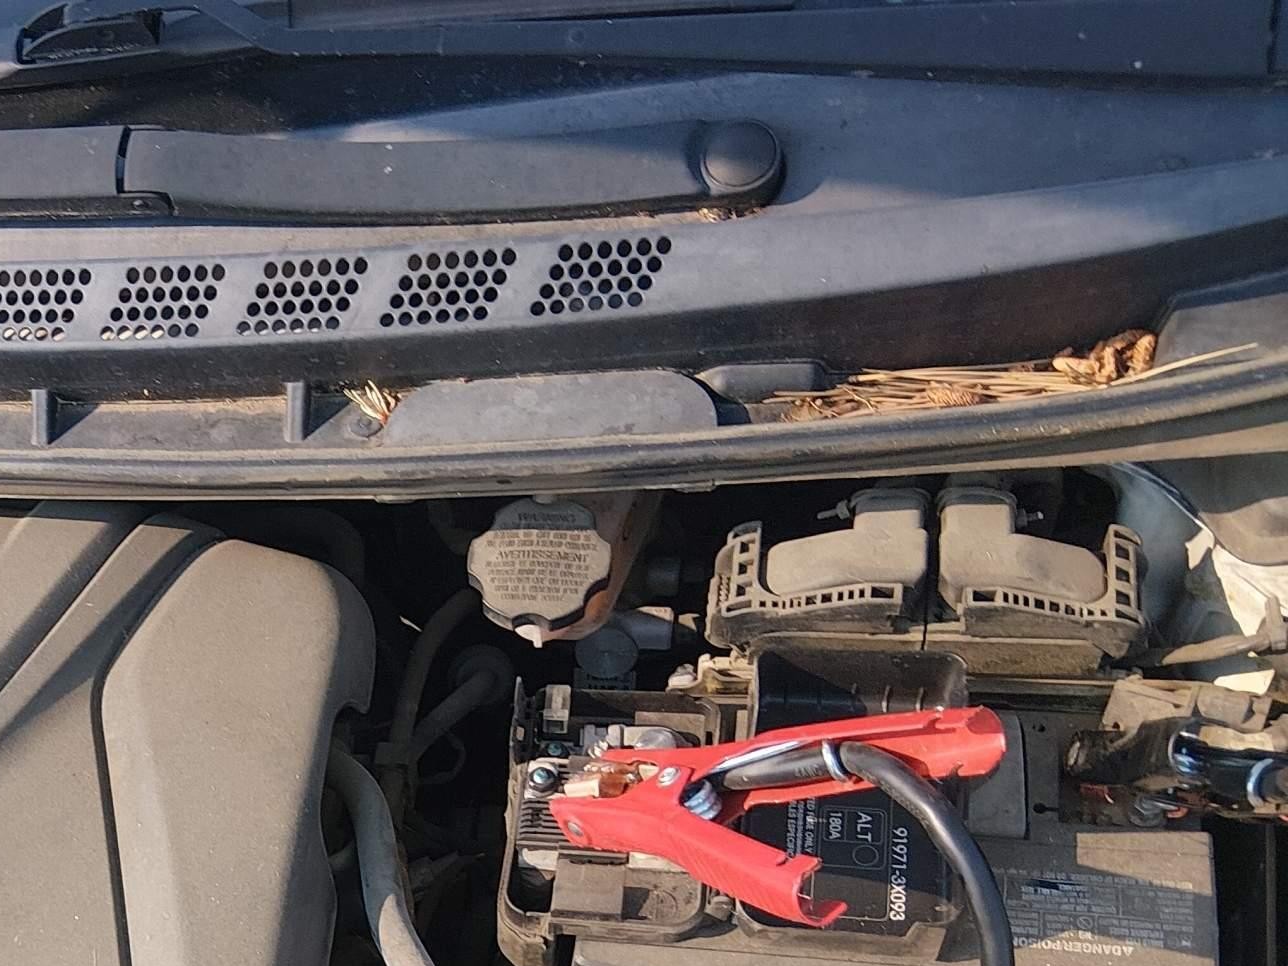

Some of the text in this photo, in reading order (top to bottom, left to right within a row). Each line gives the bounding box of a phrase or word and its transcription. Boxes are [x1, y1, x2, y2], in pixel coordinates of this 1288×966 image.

[828, 811, 843, 840] 180A
[856, 811, 873, 843] ALT
[889, 826, 908, 922] 91971-3X093
